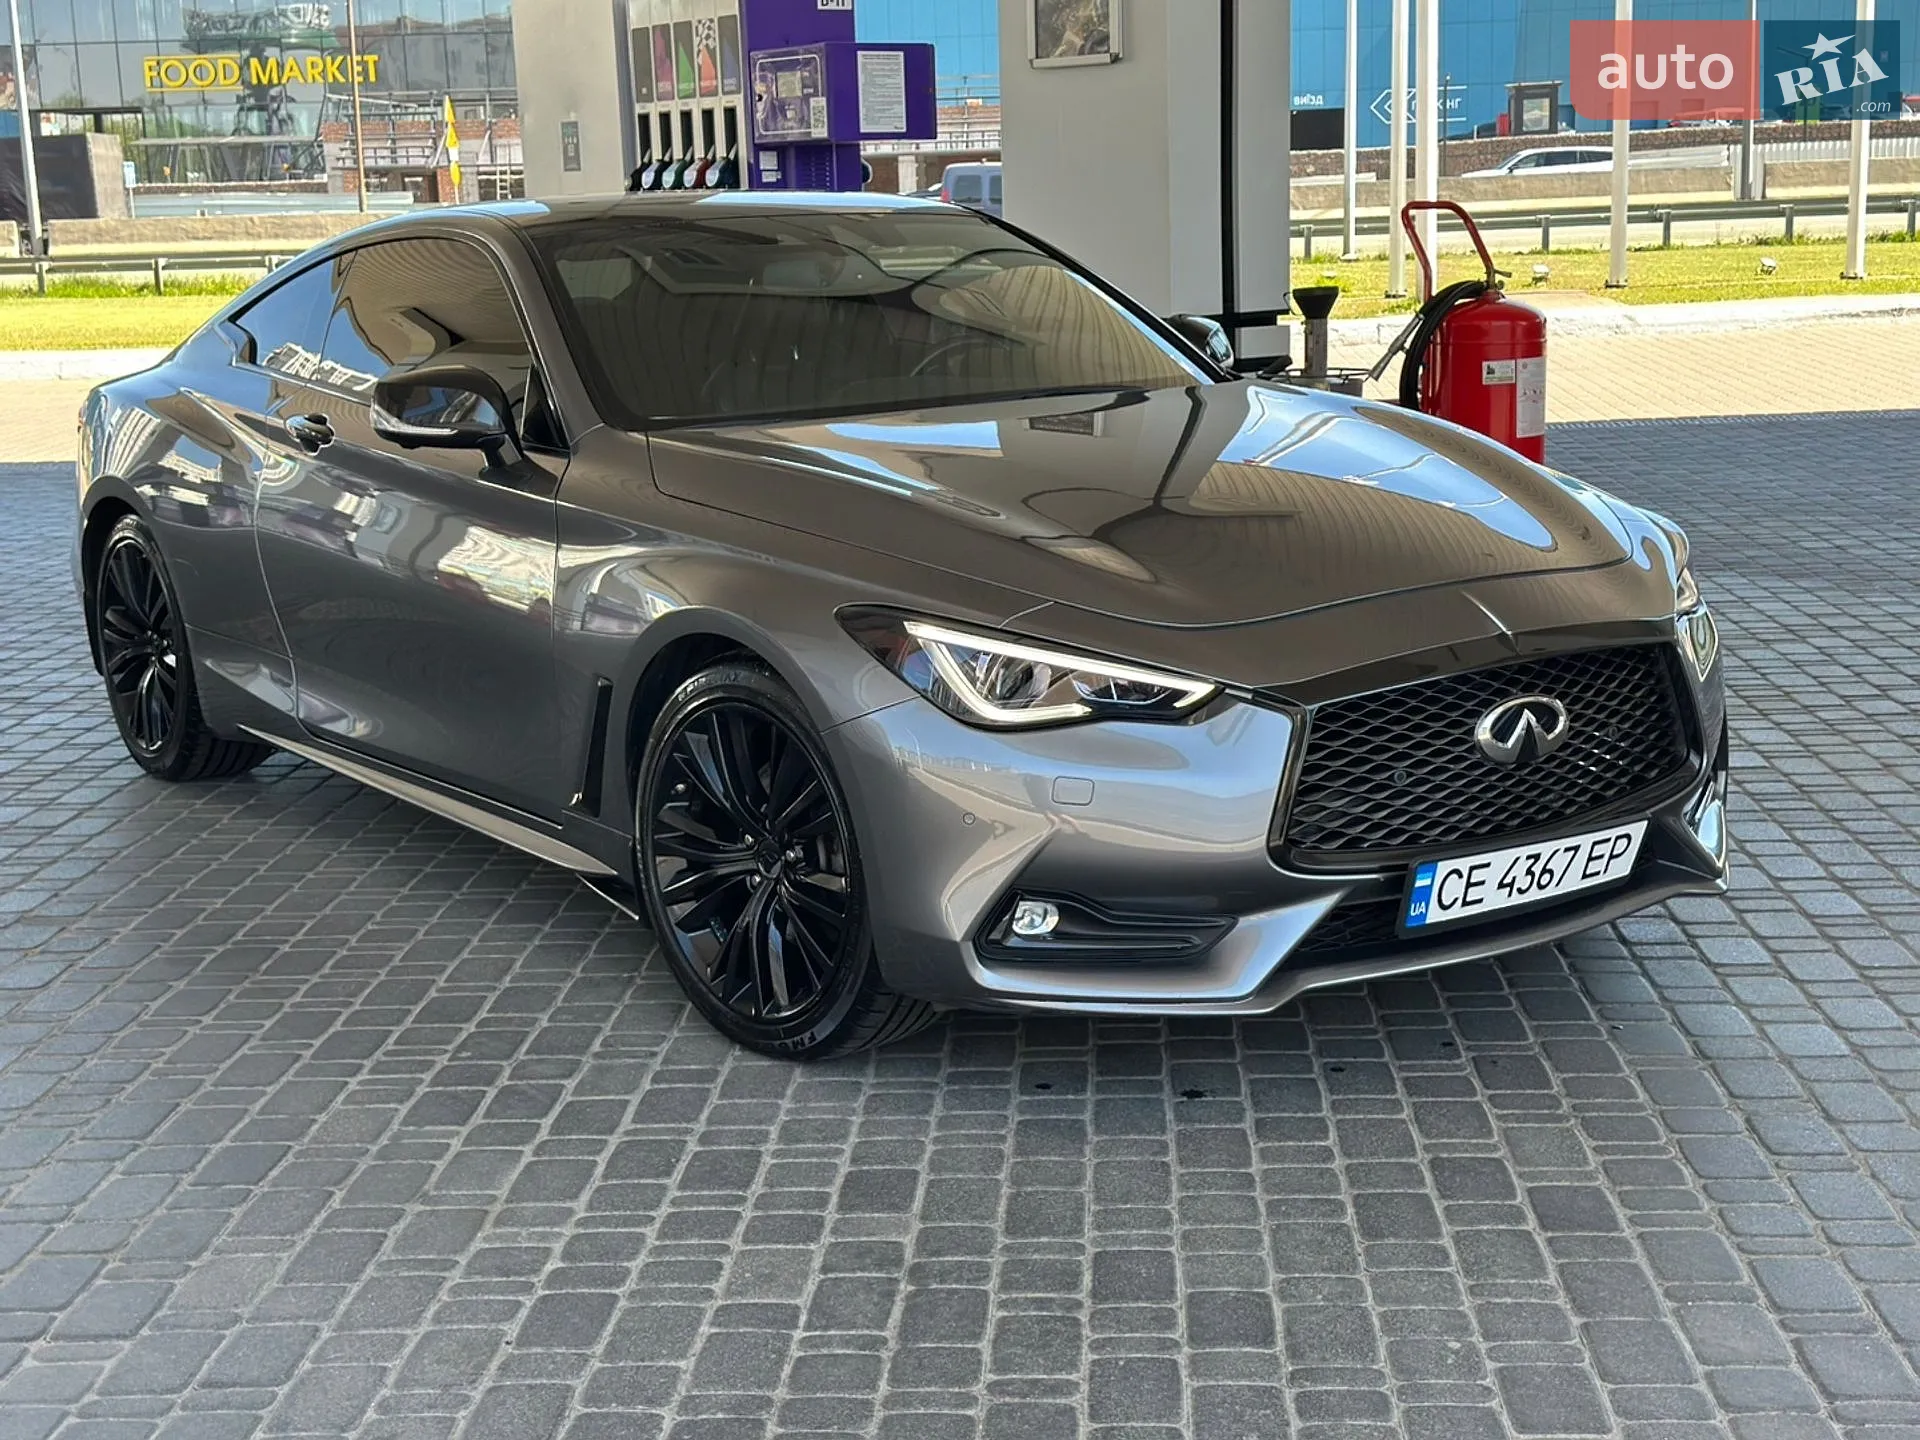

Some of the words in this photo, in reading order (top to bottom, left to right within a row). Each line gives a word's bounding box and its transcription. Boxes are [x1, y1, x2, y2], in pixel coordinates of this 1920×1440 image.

[145, 58, 241, 89] FOOD
[250, 55, 379, 85] MARKET
[1437, 862, 1491, 911] CE
[1497, 844, 1581, 898] 4367
[1581, 833, 1632, 881] EP
[1411, 904, 1427, 917] UA
